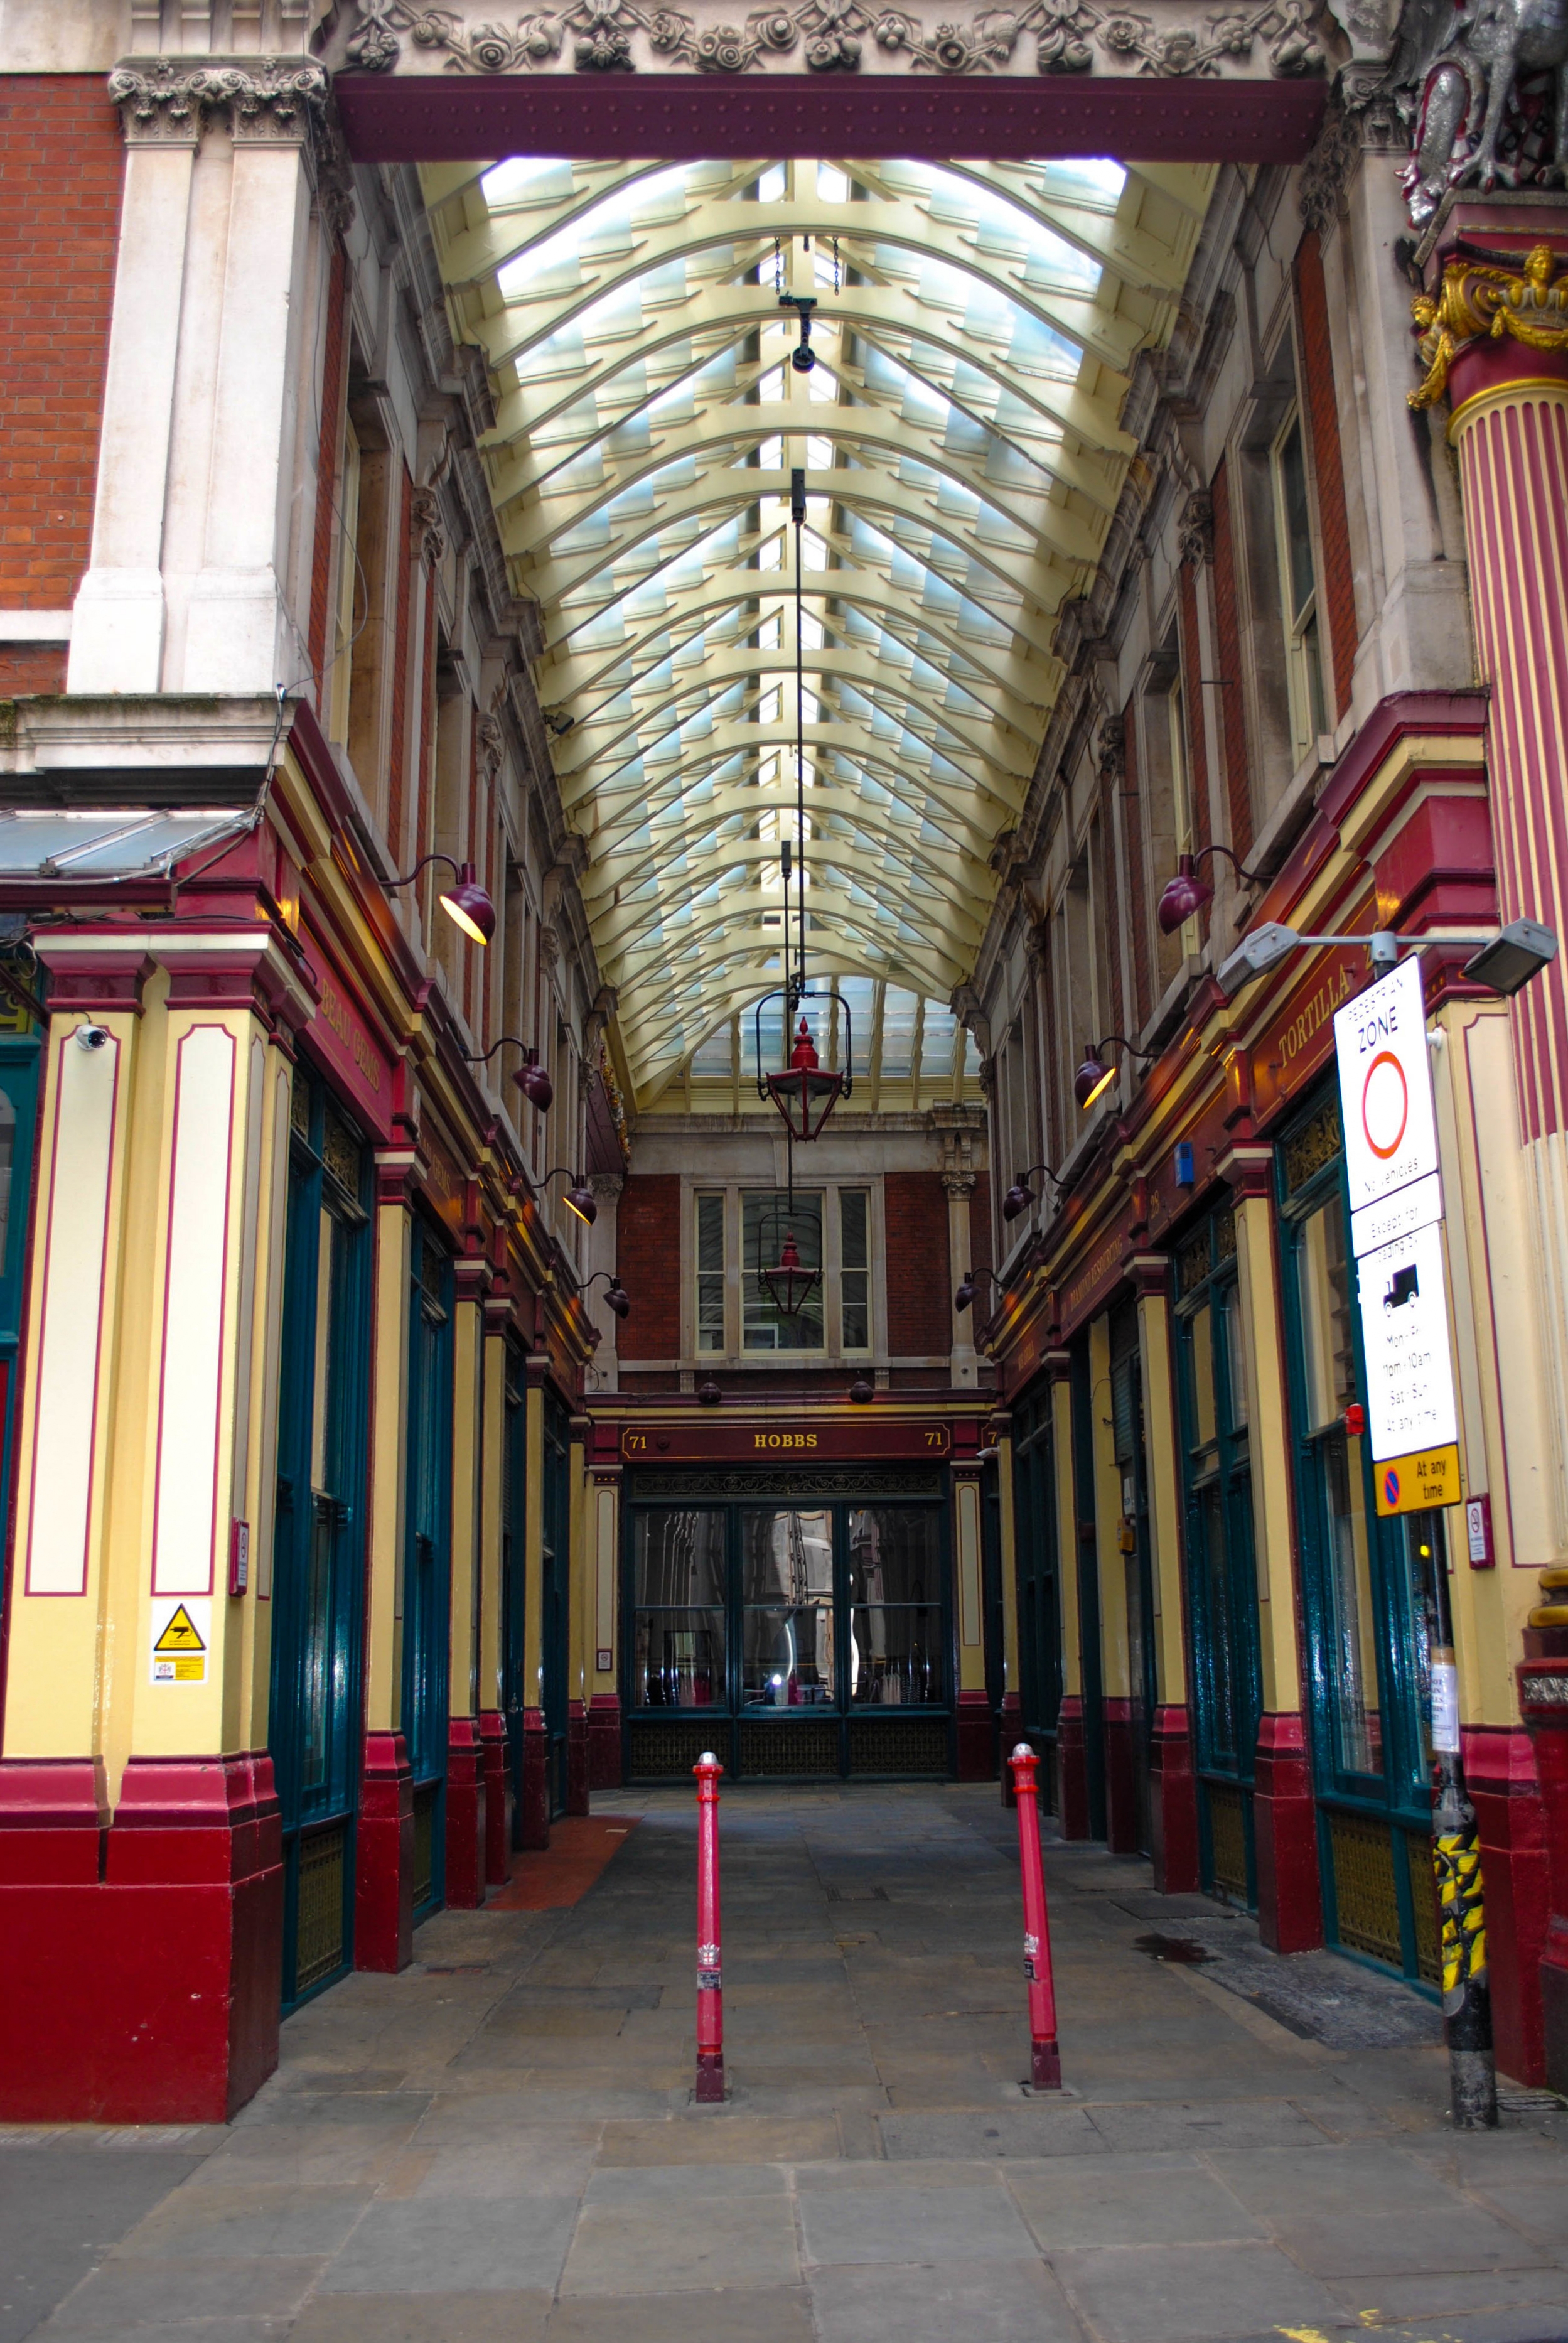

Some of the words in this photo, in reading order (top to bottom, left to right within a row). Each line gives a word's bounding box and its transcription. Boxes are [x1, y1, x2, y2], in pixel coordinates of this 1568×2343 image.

[1348, 978, 1403, 1021] PEDESTRAN
[1279, 964, 1350, 1069] TORTILLA
[321, 977, 352, 1048] BEAU
[353, 1028, 380, 1093] GEMS
[1358, 1005, 1399, 1054] ZONE
[1371, 1214, 1402, 1239] Except
[1375, 1239, 1404, 1263] oading
[1387, 1335, 1404, 1348] Mon
[1411, 1325, 1420, 1335] Fr
[1383, 1362, 1401, 1379] 11pm
[1409, 1353, 1431, 1369] 10am
[1391, 1390, 1404, 1406] Sat
[1400, 1417, 1413, 1430] any
[1417, 1409, 1436, 1425] tme
[630, 1436, 647, 1449] 71
[754, 1434, 817, 1448] HOBBS
[925, 1432, 942, 1445] 71
[1417, 1461, 1427, 1478] At
[1431, 1458, 1446, 1476] any
[1422, 1484, 1443, 1500] time
